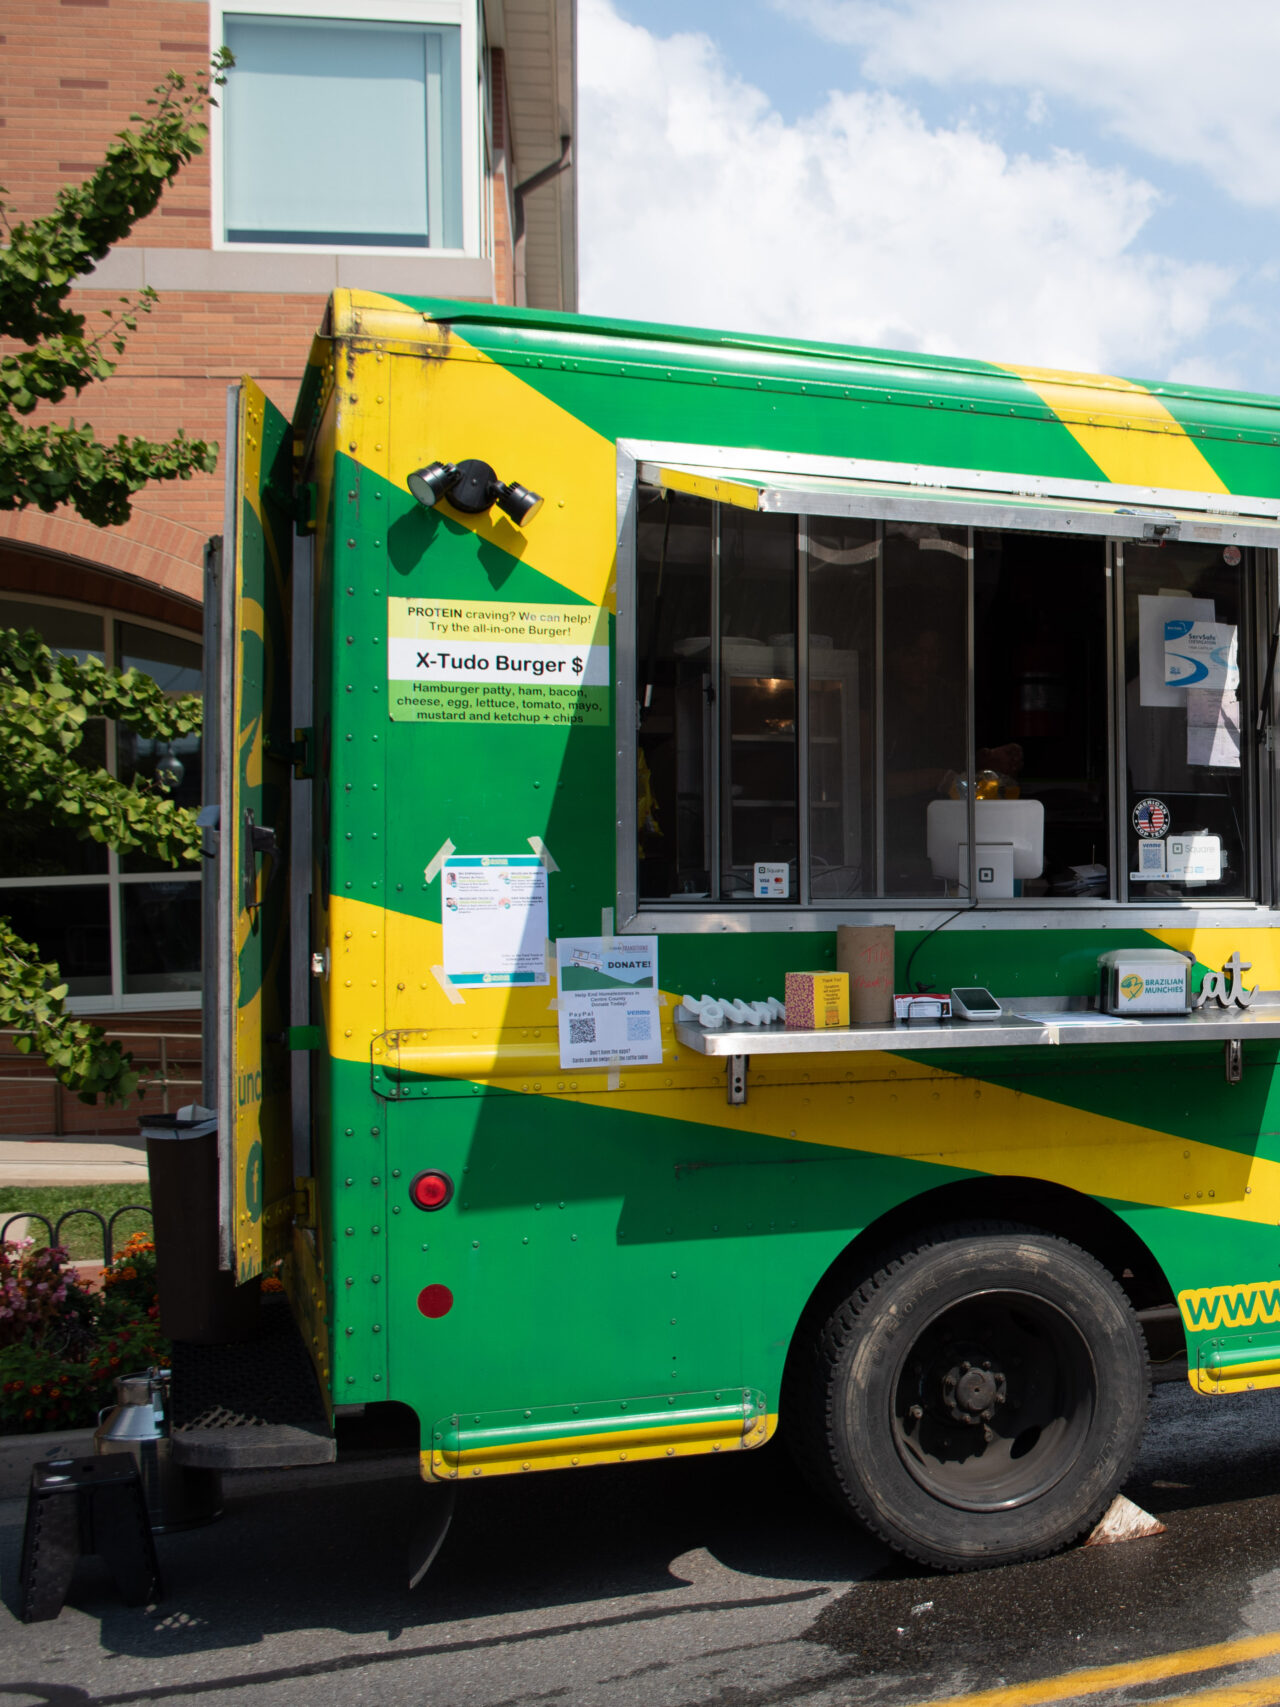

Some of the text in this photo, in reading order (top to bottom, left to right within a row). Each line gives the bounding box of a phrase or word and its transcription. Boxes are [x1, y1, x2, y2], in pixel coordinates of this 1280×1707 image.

[407, 606, 592, 625] PROTEIN craving? We can help!
[430, 621, 572, 638] Try the all-in-one Burger!
[416, 651, 584, 677] X-Tudo Burger $
[412, 682, 588, 699] Hamburger patty, ham, bacon,
[396, 695, 603, 713] cheese, egg, lettuce, tomato, mayo,
[416, 710, 467, 722] mustard
[469, 711, 491, 722] and
[493, 711, 541, 724] ketchup
[553, 712, 584, 725] chips
[1135, 799, 1167, 815] AMERICAN
[1135, 824, 1168, 839] TOP TEAM
[607, 960, 652, 969] DONATE!
[1144, 986, 1184, 995] MUNCHIES
[1145, 978, 1184, 987] BRAZILIAN
